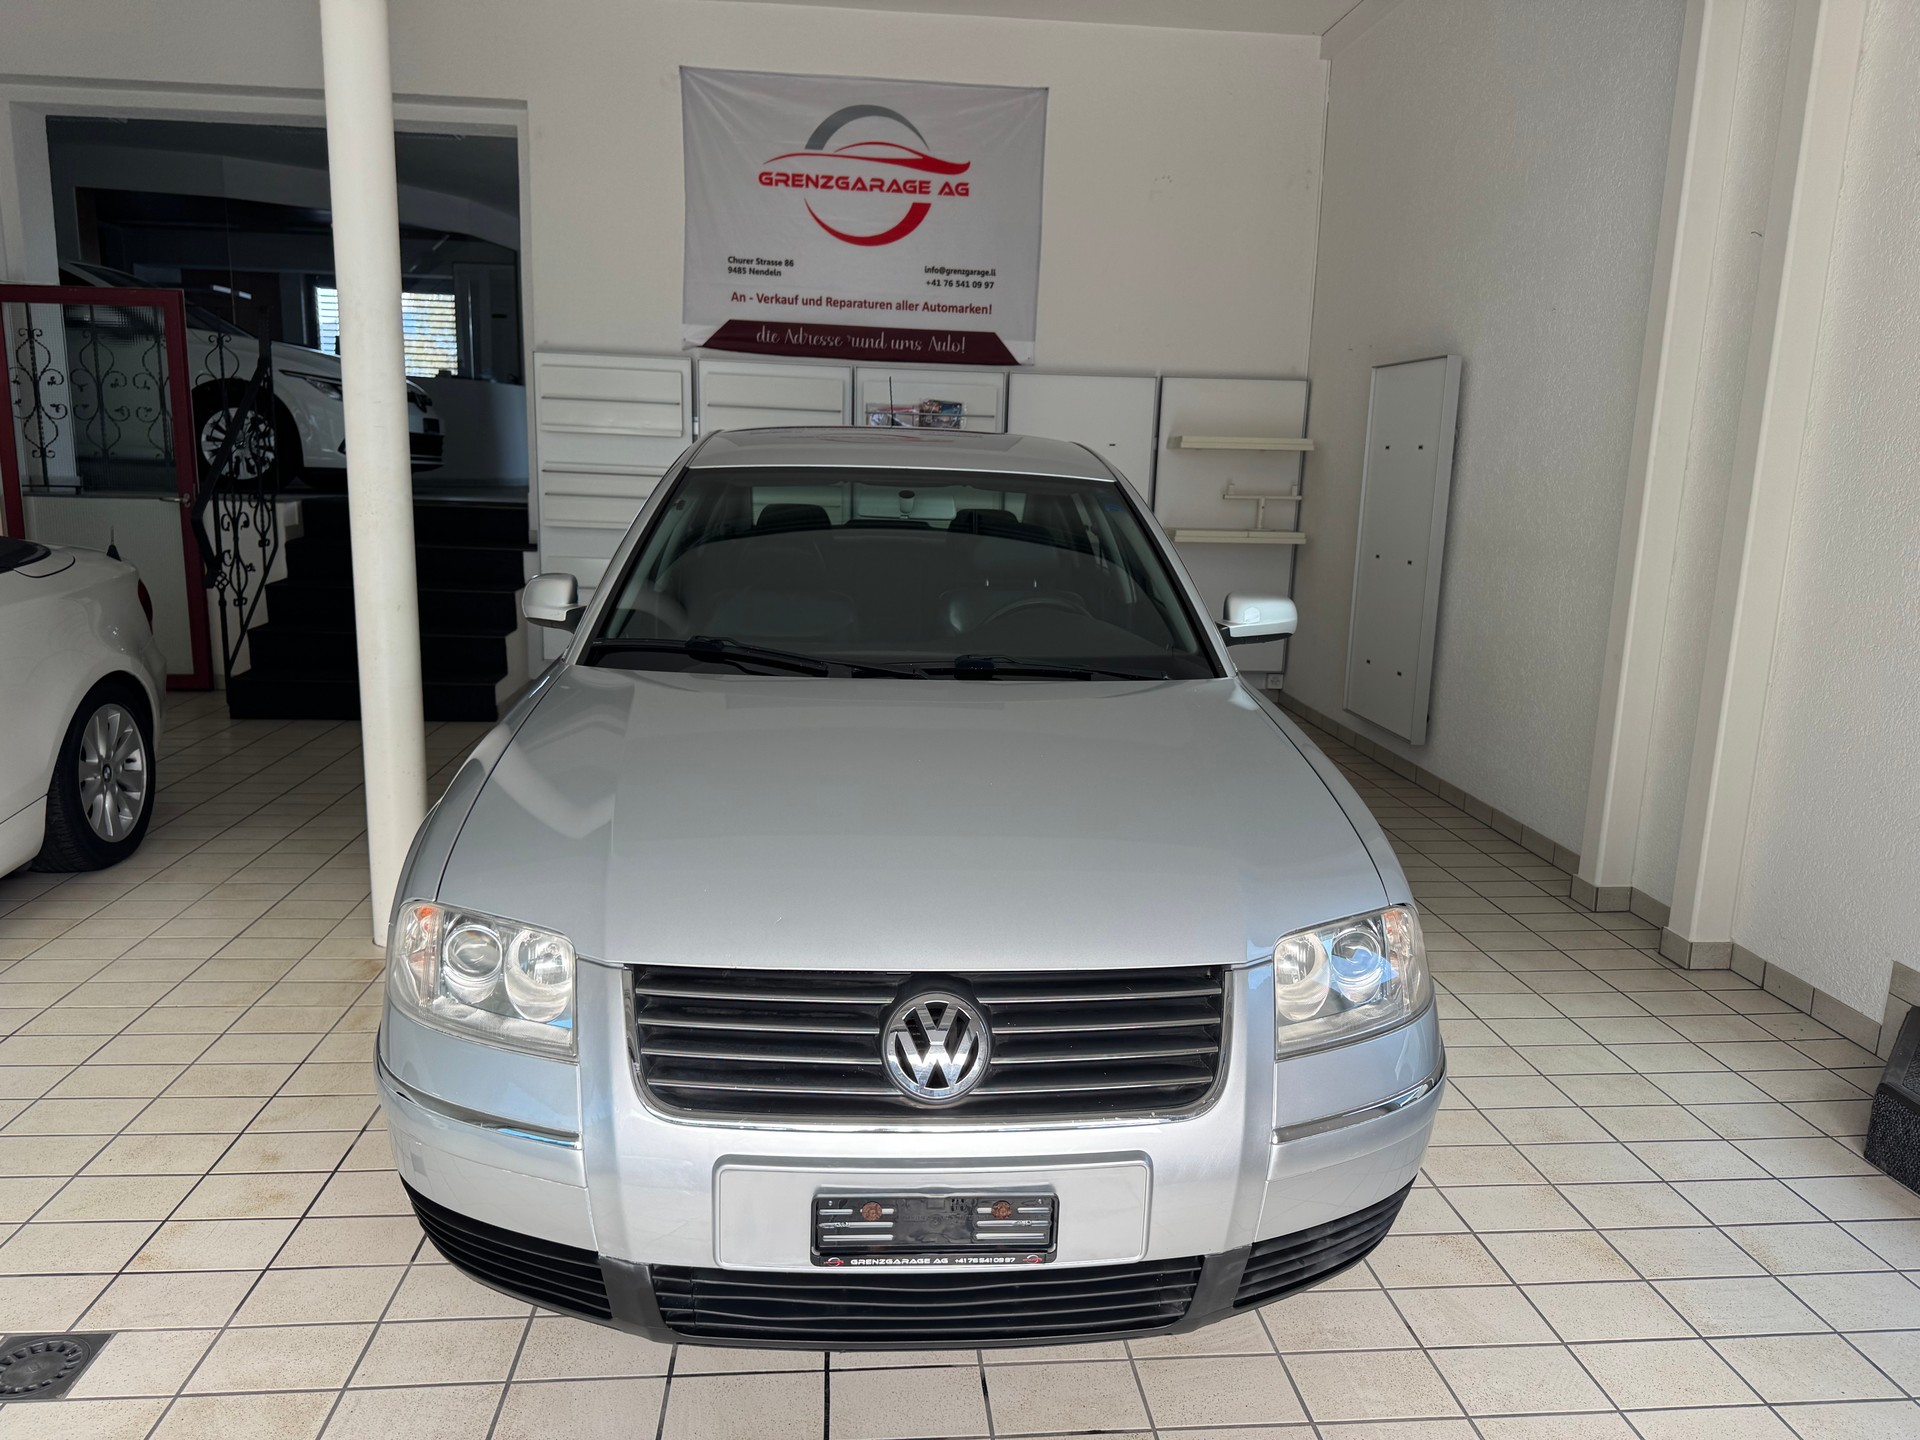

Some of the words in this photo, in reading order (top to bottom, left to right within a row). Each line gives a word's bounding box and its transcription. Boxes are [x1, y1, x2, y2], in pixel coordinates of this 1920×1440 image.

[758, 171, 931, 195] GRENZGARAGE
[938, 181, 969, 197] AG
[727, 256, 754, 265] Churer
[755, 257, 783, 267] Strasse
[784, 259, 794, 267] 86
[727, 266, 747, 275] 9485
[748, 267, 782, 276] Nendeln
[924, 265, 996, 278] info@grenzgarage.li
[926, 279, 941, 287] +41
[943, 280, 954, 288] 76
[955, 280, 970, 288] 541
[972, 281, 982, 289] 09
[984, 281, 994, 289] 97
[731, 291, 746, 303] An
[756, 292, 800, 306] Verkauf
[801, 296, 823, 307] und
[825, 296, 893, 311] Reparaturen
[895, 299, 919, 312] aller
[921, 301, 993, 315] Automarken!
[756, 324, 780, 344] die
[784, 326, 843, 347] Adresse
[890, 338, 922, 351] ums
